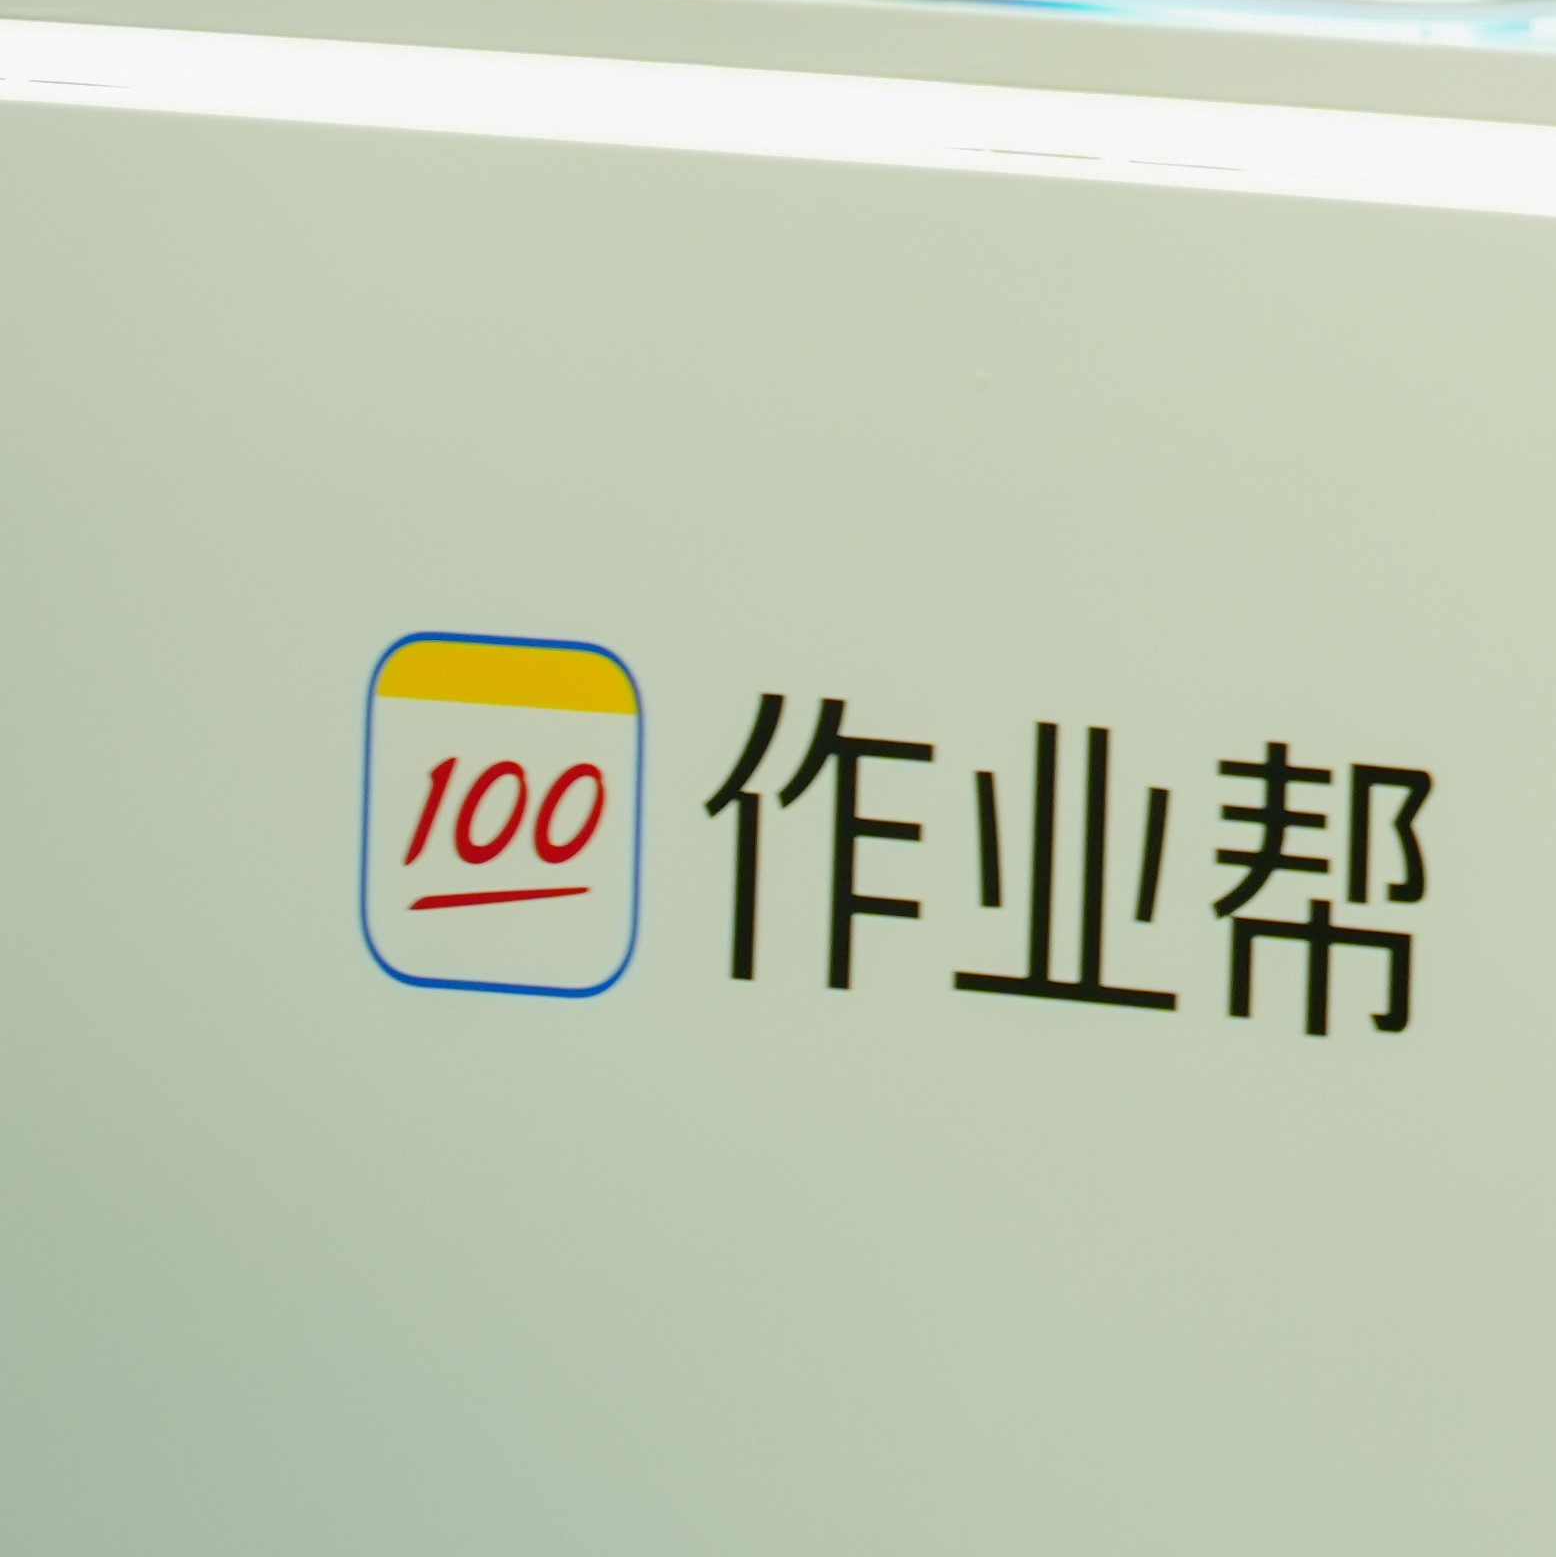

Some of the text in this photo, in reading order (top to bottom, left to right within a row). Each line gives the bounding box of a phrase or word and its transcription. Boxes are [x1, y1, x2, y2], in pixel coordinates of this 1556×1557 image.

[403, 691, 1435, 1038] 100 作业帮
